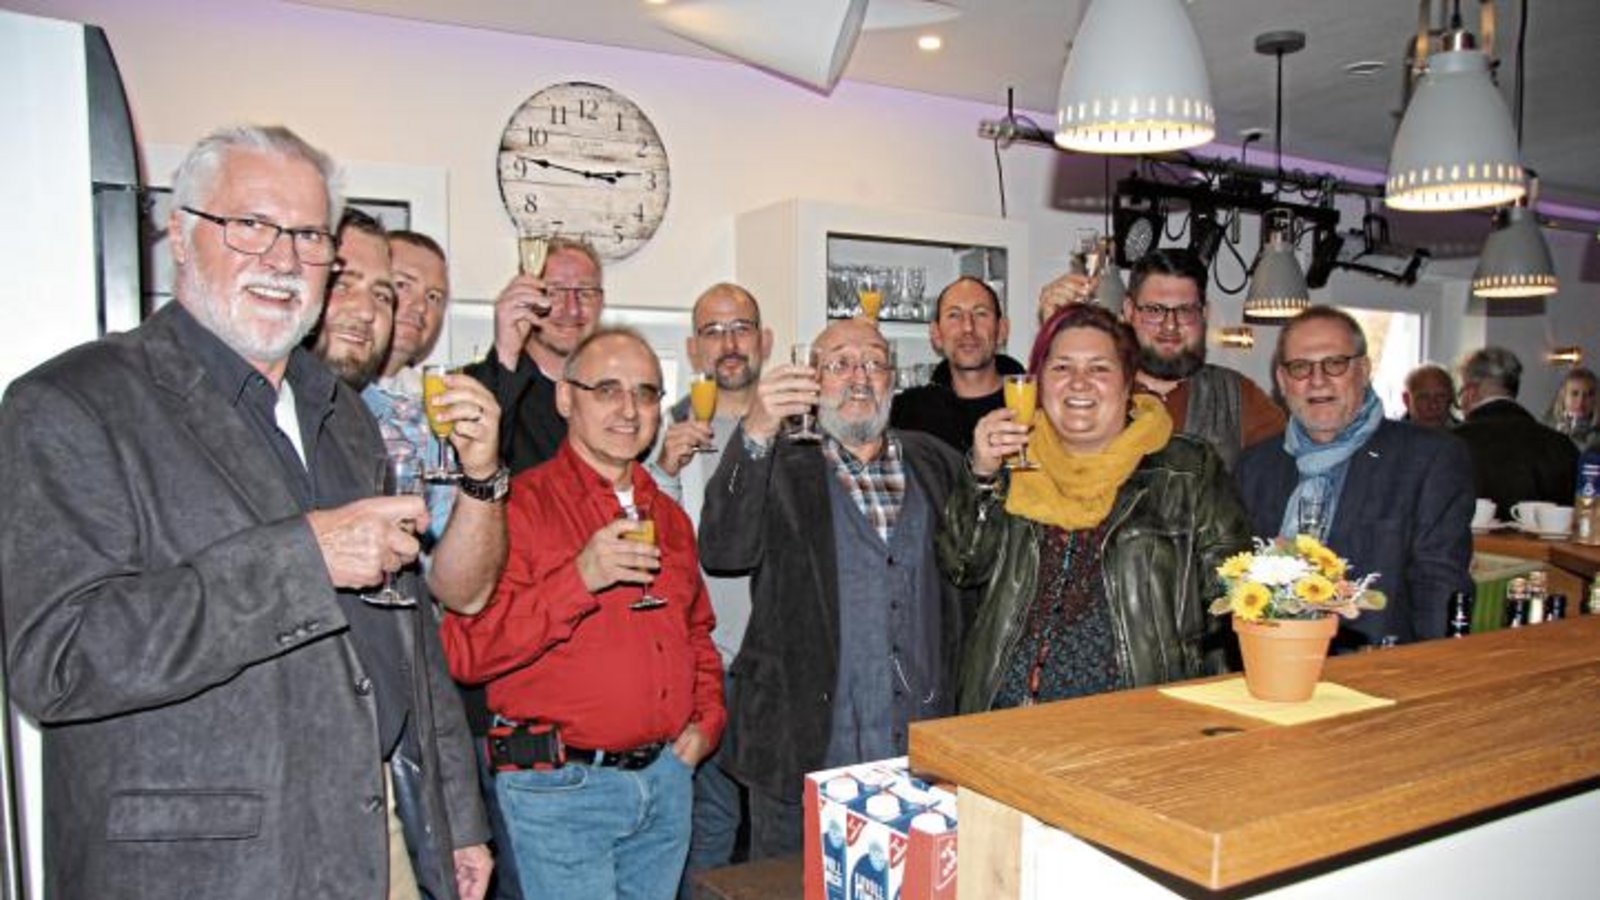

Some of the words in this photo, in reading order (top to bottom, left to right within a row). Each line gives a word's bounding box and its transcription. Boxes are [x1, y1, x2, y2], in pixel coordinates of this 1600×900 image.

[551, 106, 567, 125] 11
[579, 99, 599, 120] 12
[617, 112, 622, 131] 1
[529, 126, 549, 147] 10
[637, 138, 648, 158] 2
[513, 159, 528, 178] 9
[646, 171, 657, 190] 3
[525, 193, 538, 213] 8
[634, 203, 644, 222] 4
[613, 225, 624, 244] 5
